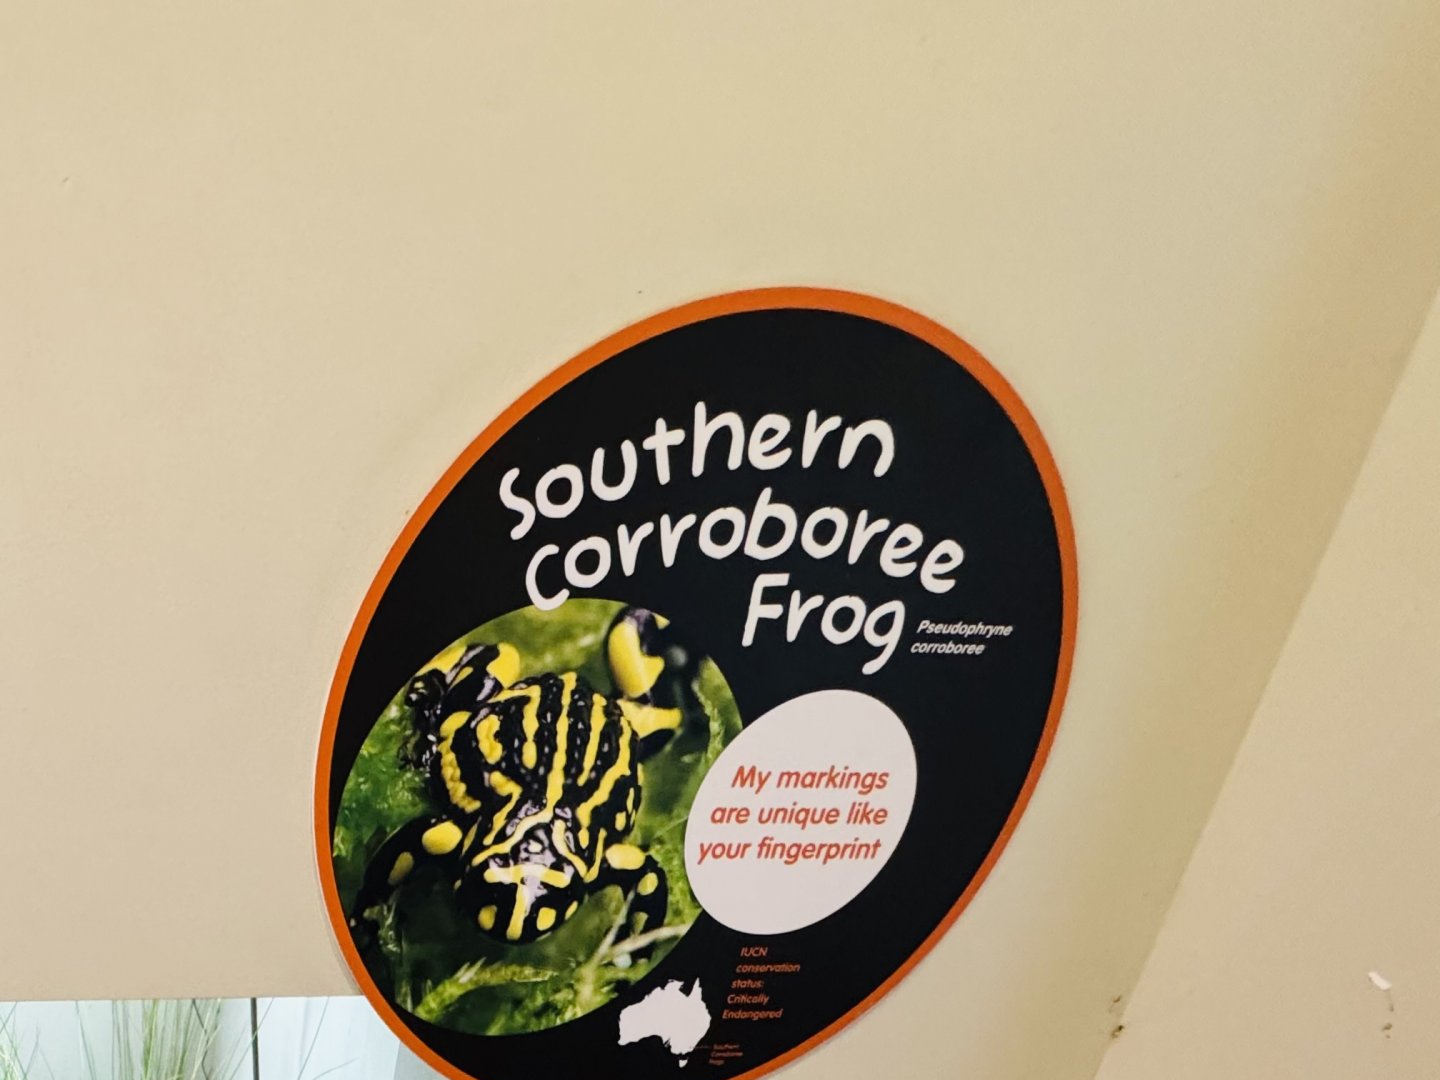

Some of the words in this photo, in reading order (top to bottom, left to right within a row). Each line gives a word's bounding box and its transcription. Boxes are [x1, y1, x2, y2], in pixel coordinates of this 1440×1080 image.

[498, 401, 896, 540] Southern
[525, 487, 965, 611] Corroboree
[742, 573, 905, 675] Frog
[916, 620, 1013, 638] Pseudophryne
[910, 640, 985, 655] corroboree
[731, 765, 772, 794] My
[776, 765, 889, 795] markings
[710, 806, 750, 824] are
[757, 801, 840, 830] unique
[846, 802, 888, 825] like
[697, 842, 751, 865] your
[757, 836, 882, 865] fingerprint
[740, 947, 768, 957] IUCN
[736, 963, 801, 973] conservation
[727, 994, 769, 1005] Critically
[722, 1008, 783, 1020] Endangered
